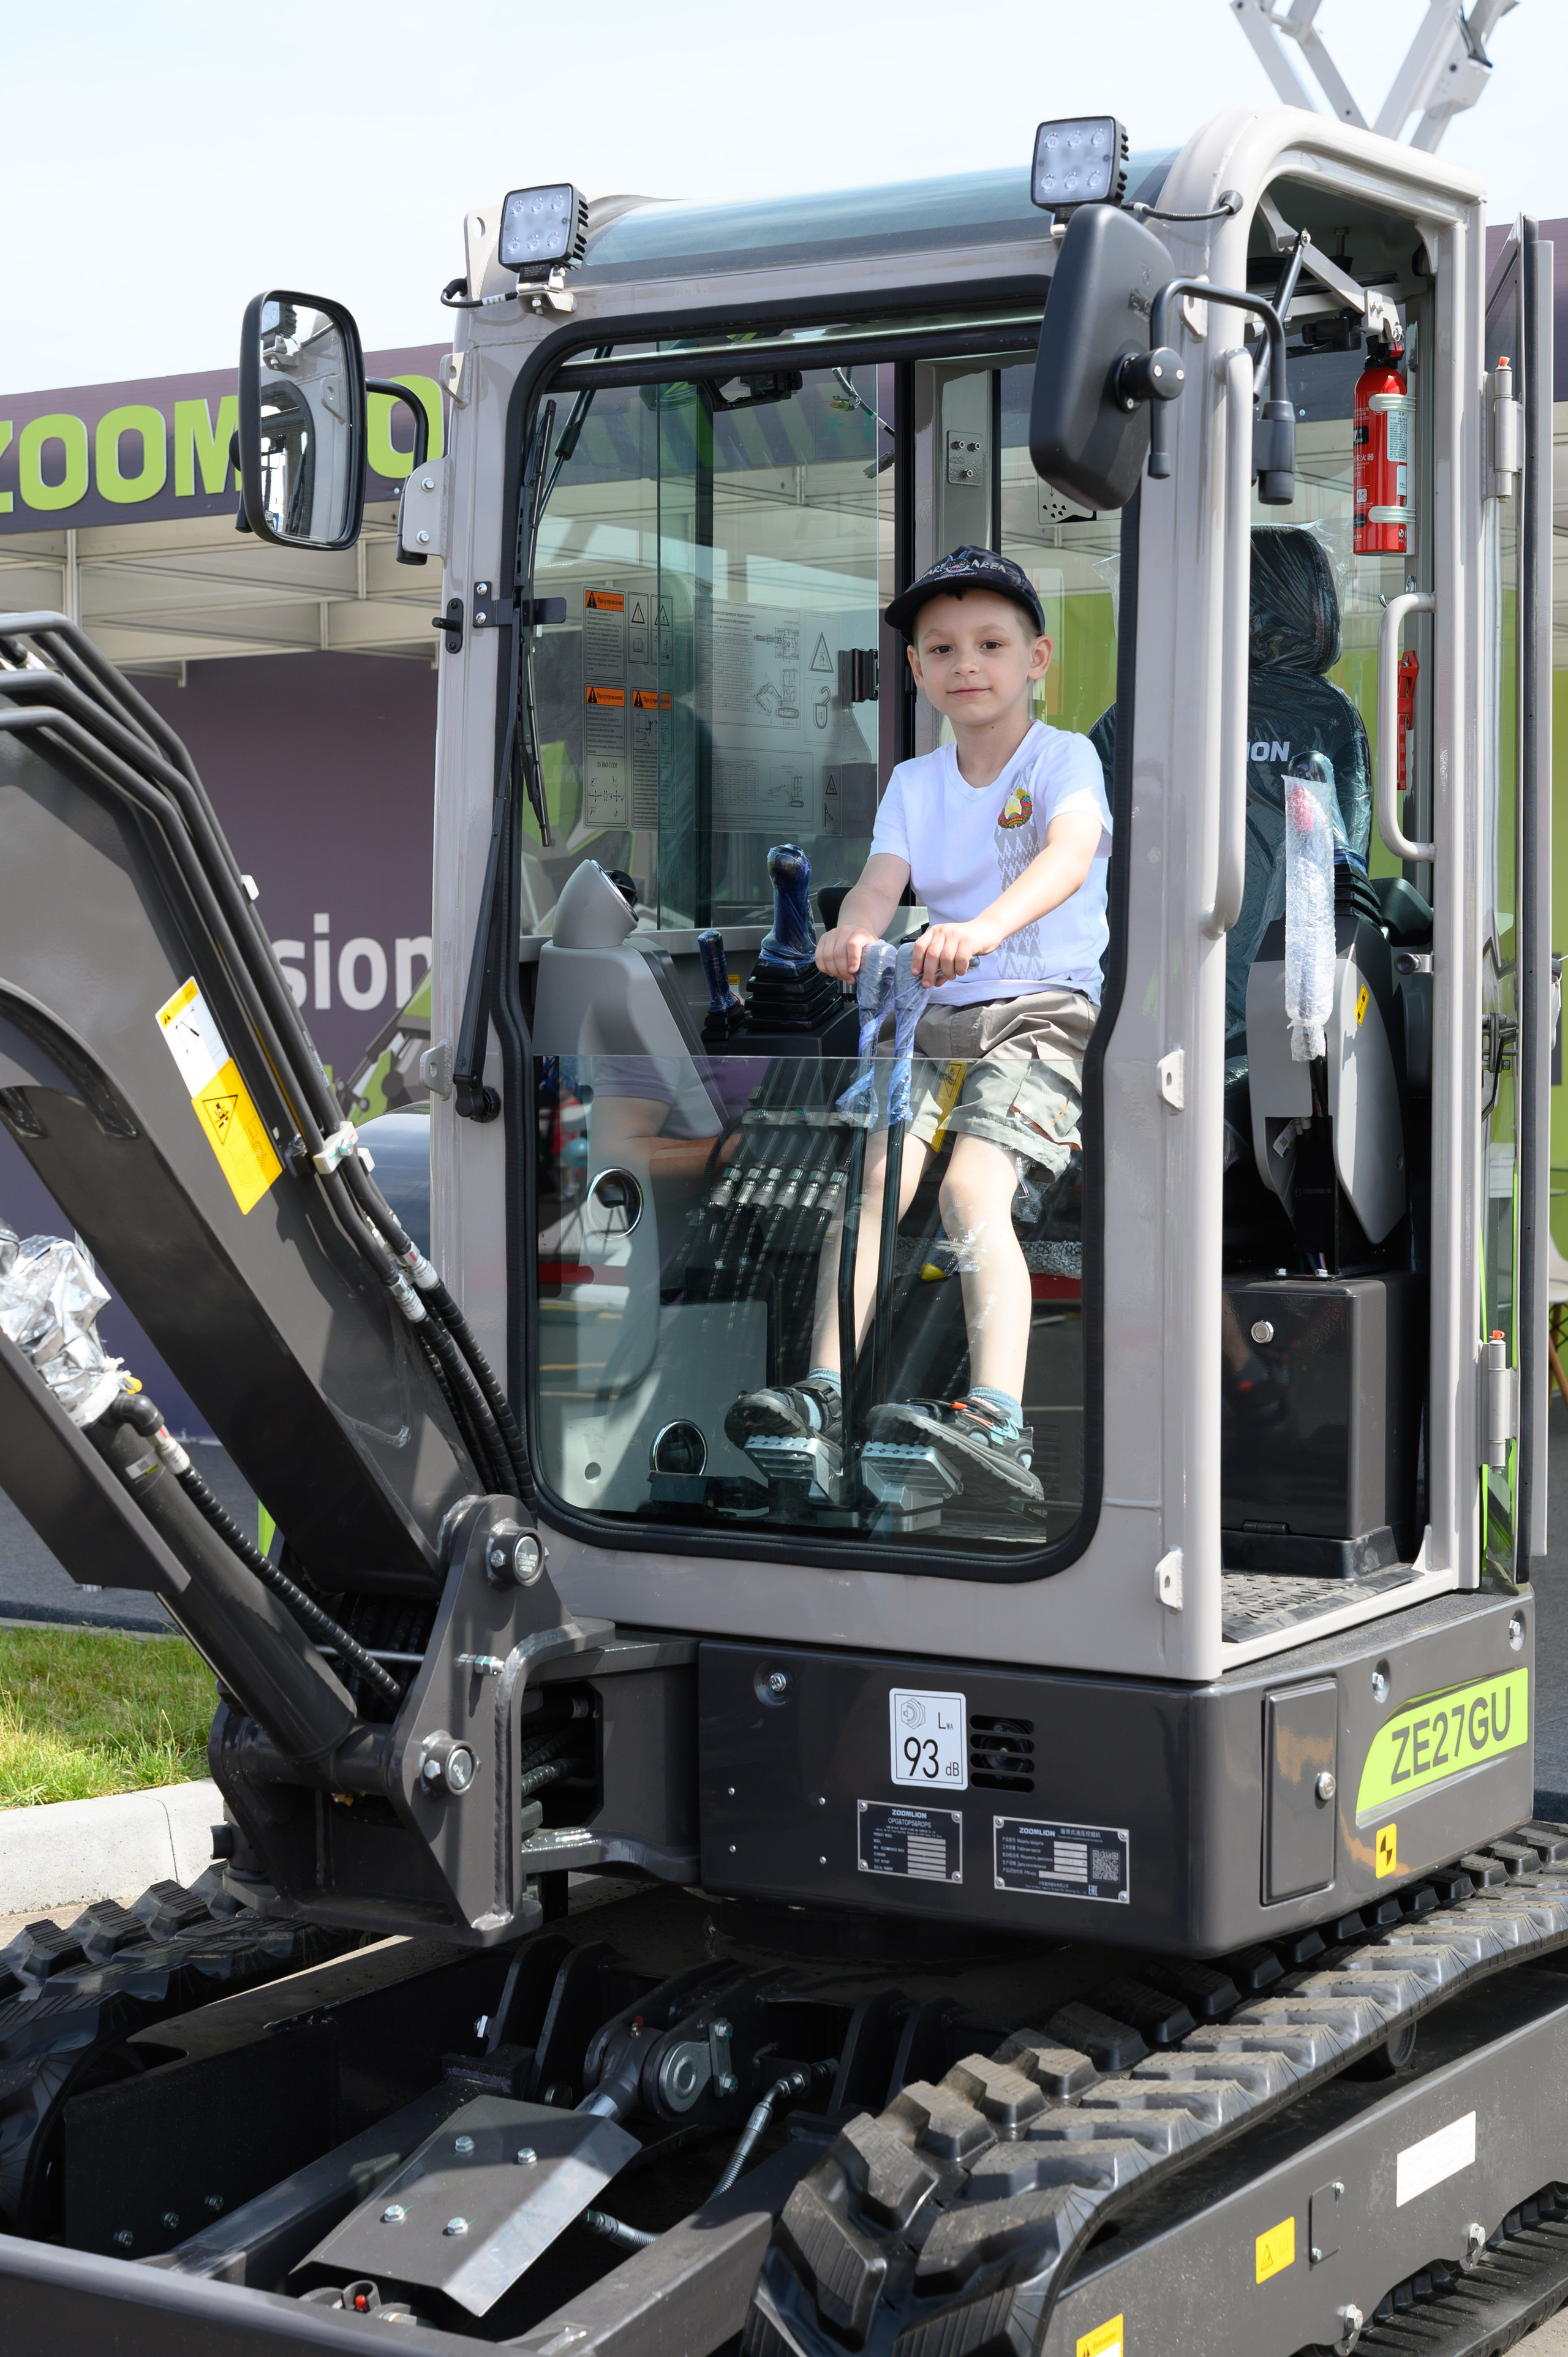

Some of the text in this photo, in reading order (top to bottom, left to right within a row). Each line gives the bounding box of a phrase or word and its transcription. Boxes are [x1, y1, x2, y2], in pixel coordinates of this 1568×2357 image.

[971, 559, 1006, 573] AREA
[1391, 1686, 1510, 1786] ZE27GU
[904, 1737, 959, 1778] 93 dB
[892, 1809, 927, 1819] ZOOMLION
[888, 1817, 932, 1828] OPG&TOPS&ROPS
[1019, 1827, 1055, 1837] ZOOMLION
